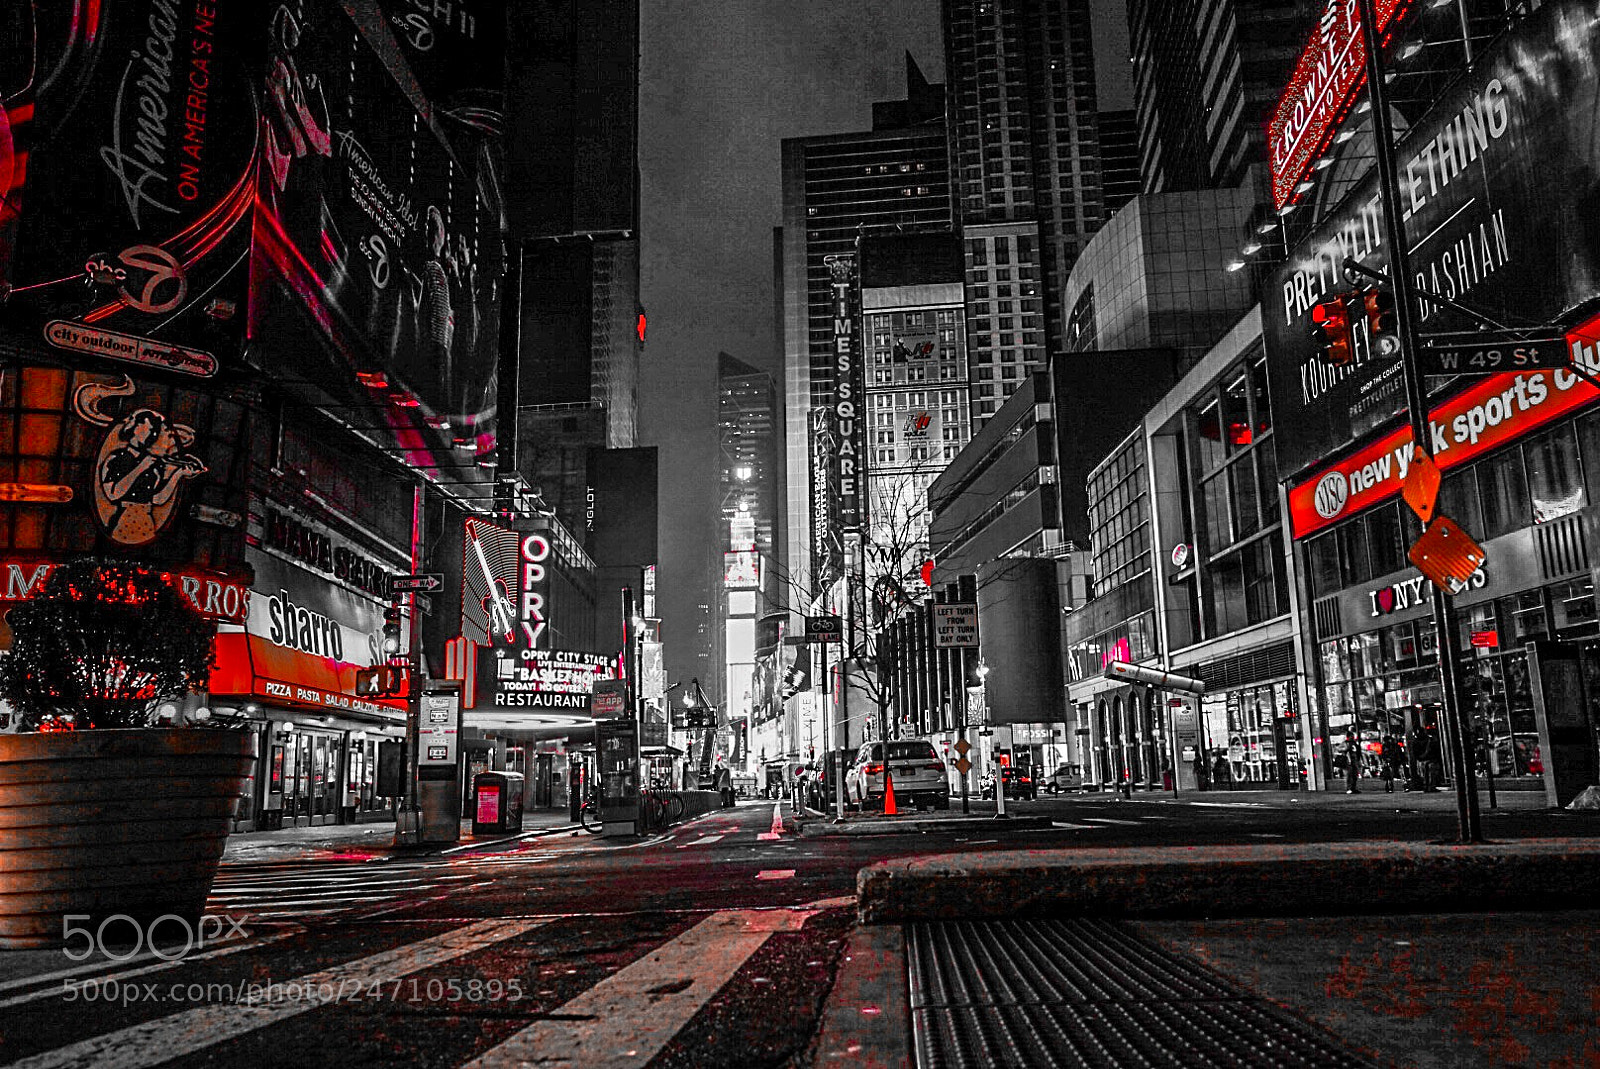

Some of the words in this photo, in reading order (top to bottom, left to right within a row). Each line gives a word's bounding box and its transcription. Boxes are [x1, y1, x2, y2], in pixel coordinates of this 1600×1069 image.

[193, 0, 216, 36] NE
[182, 38, 213, 160] AMERICA'S
[1276, 31, 1340, 165] CROWNE
[1318, 52, 1355, 120] HOTEL
[177, 162, 200, 200] ON
[334, 130, 395, 204] American
[396, 193, 419, 231] Idol
[53, 328, 80, 345] city
[82, 334, 136, 354] outdoor
[834, 283, 851, 372] TIMES
[1439, 352, 1460, 370] W
[1469, 349, 1502, 367] 49
[1512, 347, 1540, 365] St
[1360, 380, 1373, 394] SHOP
[1373, 374, 1382, 384] THE
[836, 382, 855, 496] SQUARE
[1349, 452, 1391, 496] new
[1394, 420, 1449, 480] yk
[1453, 372, 1548, 445] sports
[814, 494, 822, 557] AMERICAN
[397, 579, 413, 588] ONE
[419, 579, 436, 588] WAY
[521, 535, 550, 649] OPRY
[1369, 591, 1379, 617] I
[1392, 576, 1424, 610] NY
[269, 588, 344, 662] sbarro
[937, 607, 953, 617] LEFT
[956, 607, 974, 616] TURN
[946, 617, 966, 625] FROM
[806, 633, 822, 641] BIKE
[822, 633, 840, 641] LANE
[938, 626, 954, 635] LEFT
[957, 625, 975, 634] TURN
[940, 635, 954, 643] BAY
[956, 634, 974, 643] ONLY
[521, 649, 551, 661] OPRY
[556, 651, 580, 663] CITY
[583, 653, 608, 666] STAGE
[266, 682, 291, 698] PIZZA
[297, 688, 320, 703] PASTA
[325, 693, 349, 708] SALAD
[352, 699, 380, 713] CALZONE
[495, 692, 587, 708] RESTAURANT
[503, 682, 536, 691] TODAY!
